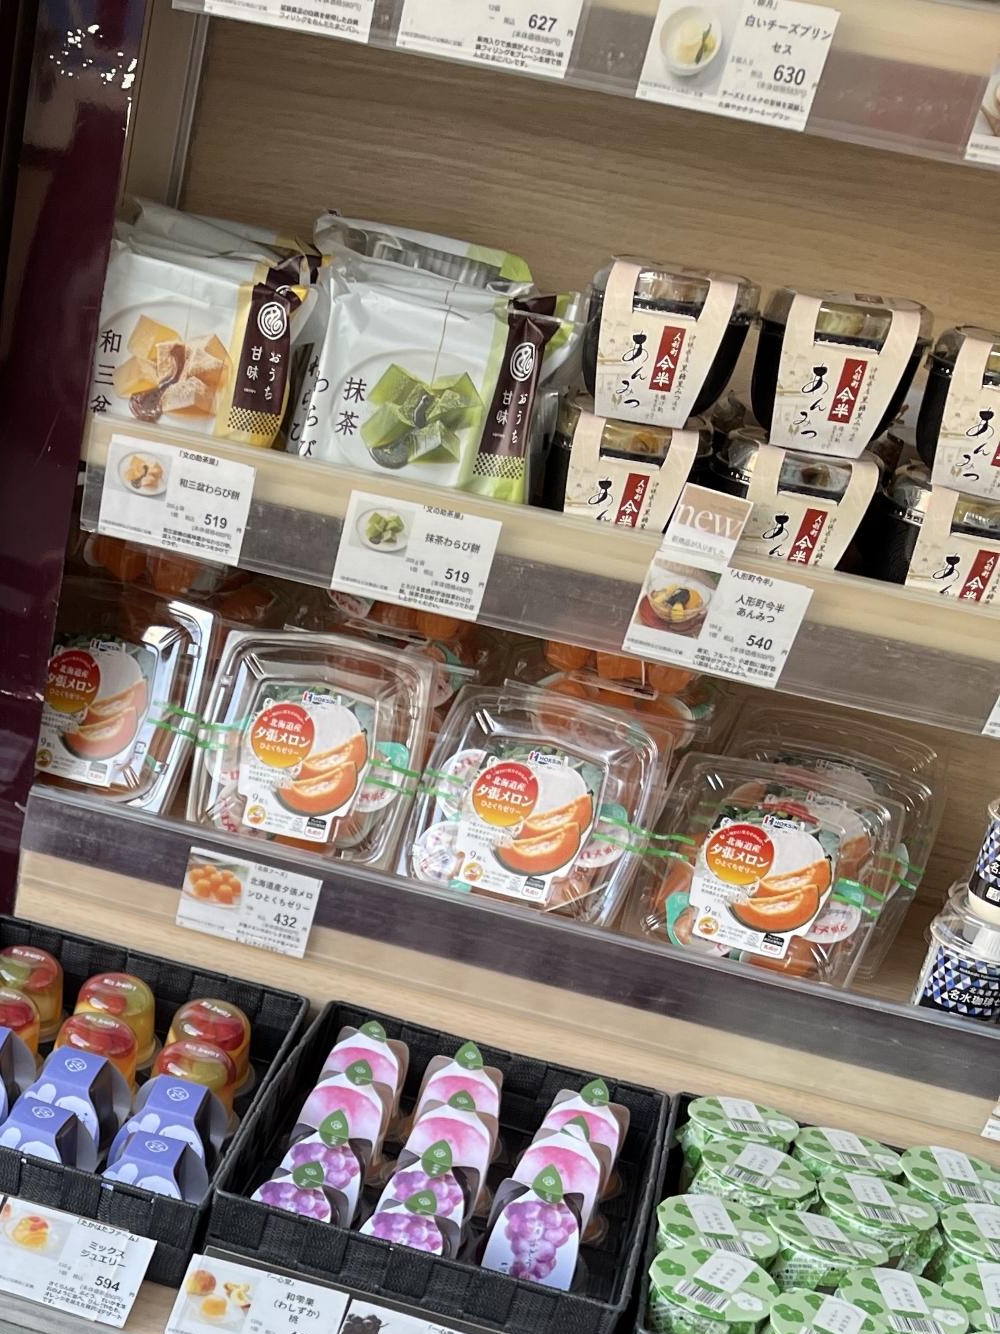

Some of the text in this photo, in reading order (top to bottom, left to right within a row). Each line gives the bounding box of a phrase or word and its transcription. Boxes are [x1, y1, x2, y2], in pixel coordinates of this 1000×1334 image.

[528, 14, 557, 33] 627
[745, 15, 832, 41] 白いチーズプリン
[772, 42, 792, 55] セス
[773, 64, 806, 85] 630
[246, 346, 262, 381] 甘味
[264, 353, 282, 400] おうち
[335, 377, 367, 435] 抹茶
[496, 391, 513, 425] 甘味
[510, 393, 527, 444] おうち
[180, 478, 240, 501] 和三盆わらび餅
[204, 514, 227, 529] 519
[675, 503, 743, 539] new
[425, 533, 481, 554] 抹茶わらび餅
[445, 568, 470, 584] 519
[736, 594, 785, 613] 人形町今半
[737, 609, 775, 623] あんみつ
[746, 635, 773, 651] 540
[270, 718, 303, 732] 北海道産
[254, 727, 311, 747] 夕張メロン
[492, 776, 527, 792] 北海道産
[476, 784, 534, 807] 夕張メロン
[726, 837, 762, 853] 北海道産
[709, 843, 769, 868] 夕張メロン
[250, 877, 313, 899] 北海道産夕張メロ
[247, 890, 311, 912] ンひとくちゼリー
[273, 913, 297, 929] 432
[80, 1250, 127, 1269] ジュエリー
[88, 1241, 125, 1259] ミックス
[94, 1276, 120, 1292] 594
[273, 1299, 321, 1320] (わしずか)
[288, 1315, 299, 1325] 桃
